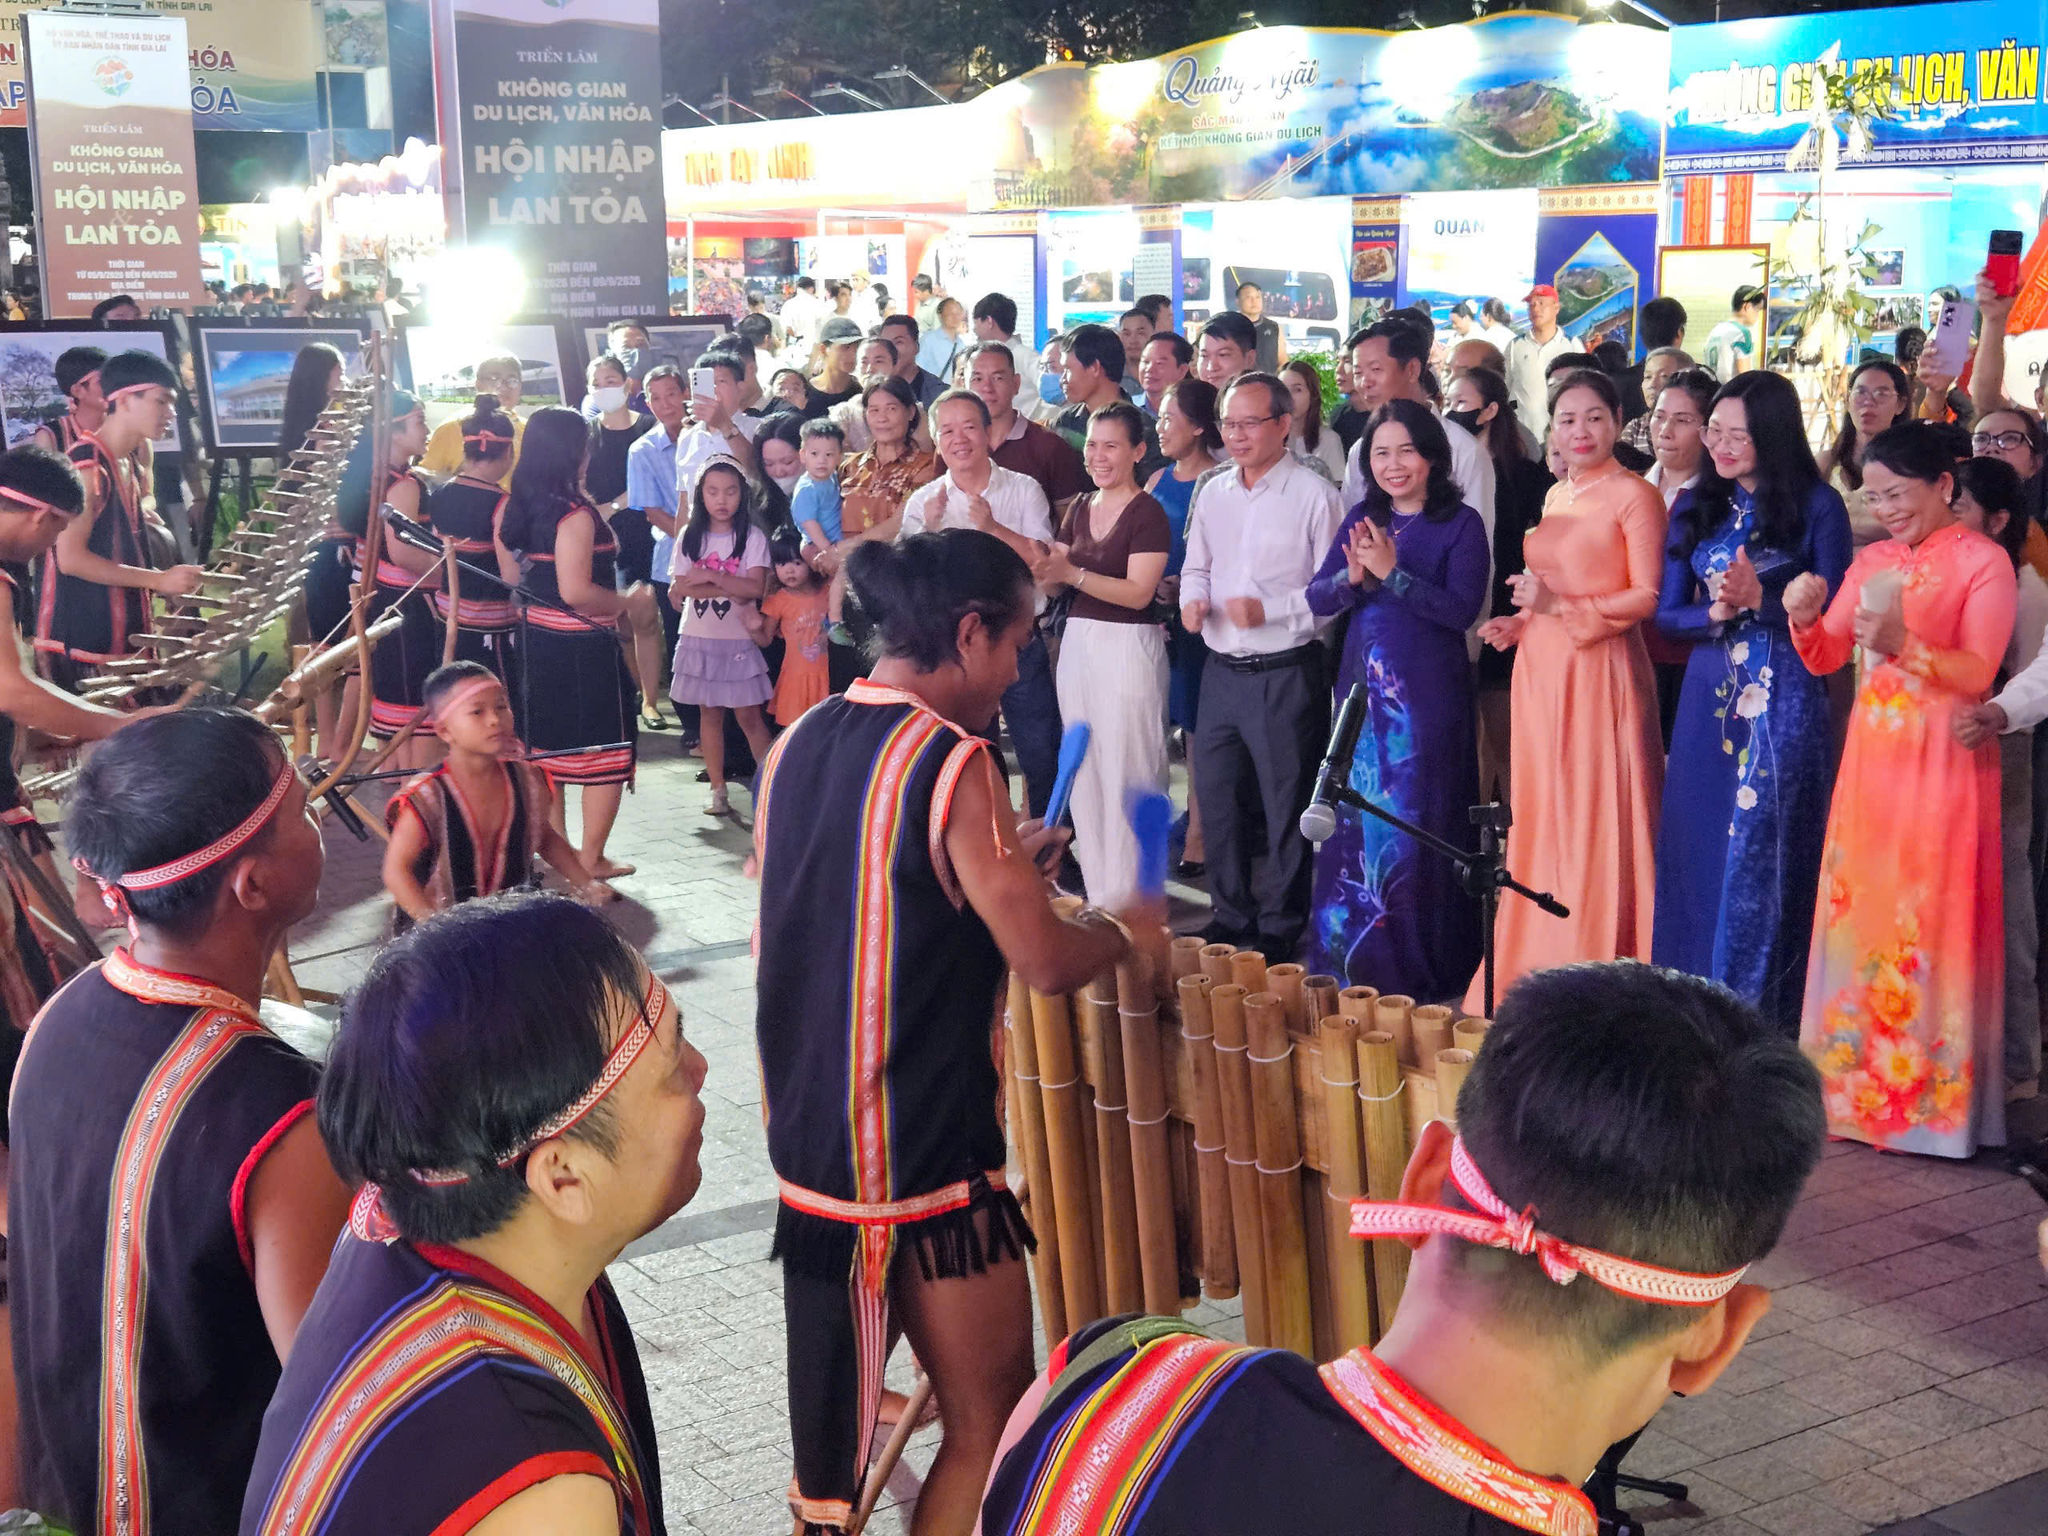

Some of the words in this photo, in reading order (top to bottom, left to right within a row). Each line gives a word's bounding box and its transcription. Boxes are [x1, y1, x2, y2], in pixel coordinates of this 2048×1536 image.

[517, 46, 563, 63] TRIỂN
[498, 77, 573, 97] KHÔNG
[577, 82, 627, 98] GIAN
[1900, 51, 1971, 115] LỊCH,
[1978, 38, 2040, 101] VĂN
[473, 105, 502, 121] DU
[507, 105, 560, 126] LỊCH,
[563, 102, 605, 122] VĂN
[609, 102, 653, 122] HÓA
[1277, 127, 1292, 139] DU
[1296, 126, 1322, 141] LỊCH
[70, 142, 125, 157] KHÔNG
[127, 146, 164, 158] GIAN
[474, 137, 545, 183] HỘI
[554, 138, 656, 182] NHẬP
[53, 161, 74, 173] DU
[77, 162, 116, 176] LỊCH,
[118, 160, 149, 174] VĂN
[151, 161, 183, 174] HÓA
[55, 184, 106, 215] HỘI
[112, 185, 186, 216] NHẬP
[487, 197, 561, 225] LAN
[569, 187, 648, 224] TỎA
[65, 224, 119, 245] LAN
[123, 219, 182, 245] TỎA
[621, 305, 638, 316] GIA
[640, 304, 656, 316] LAI
